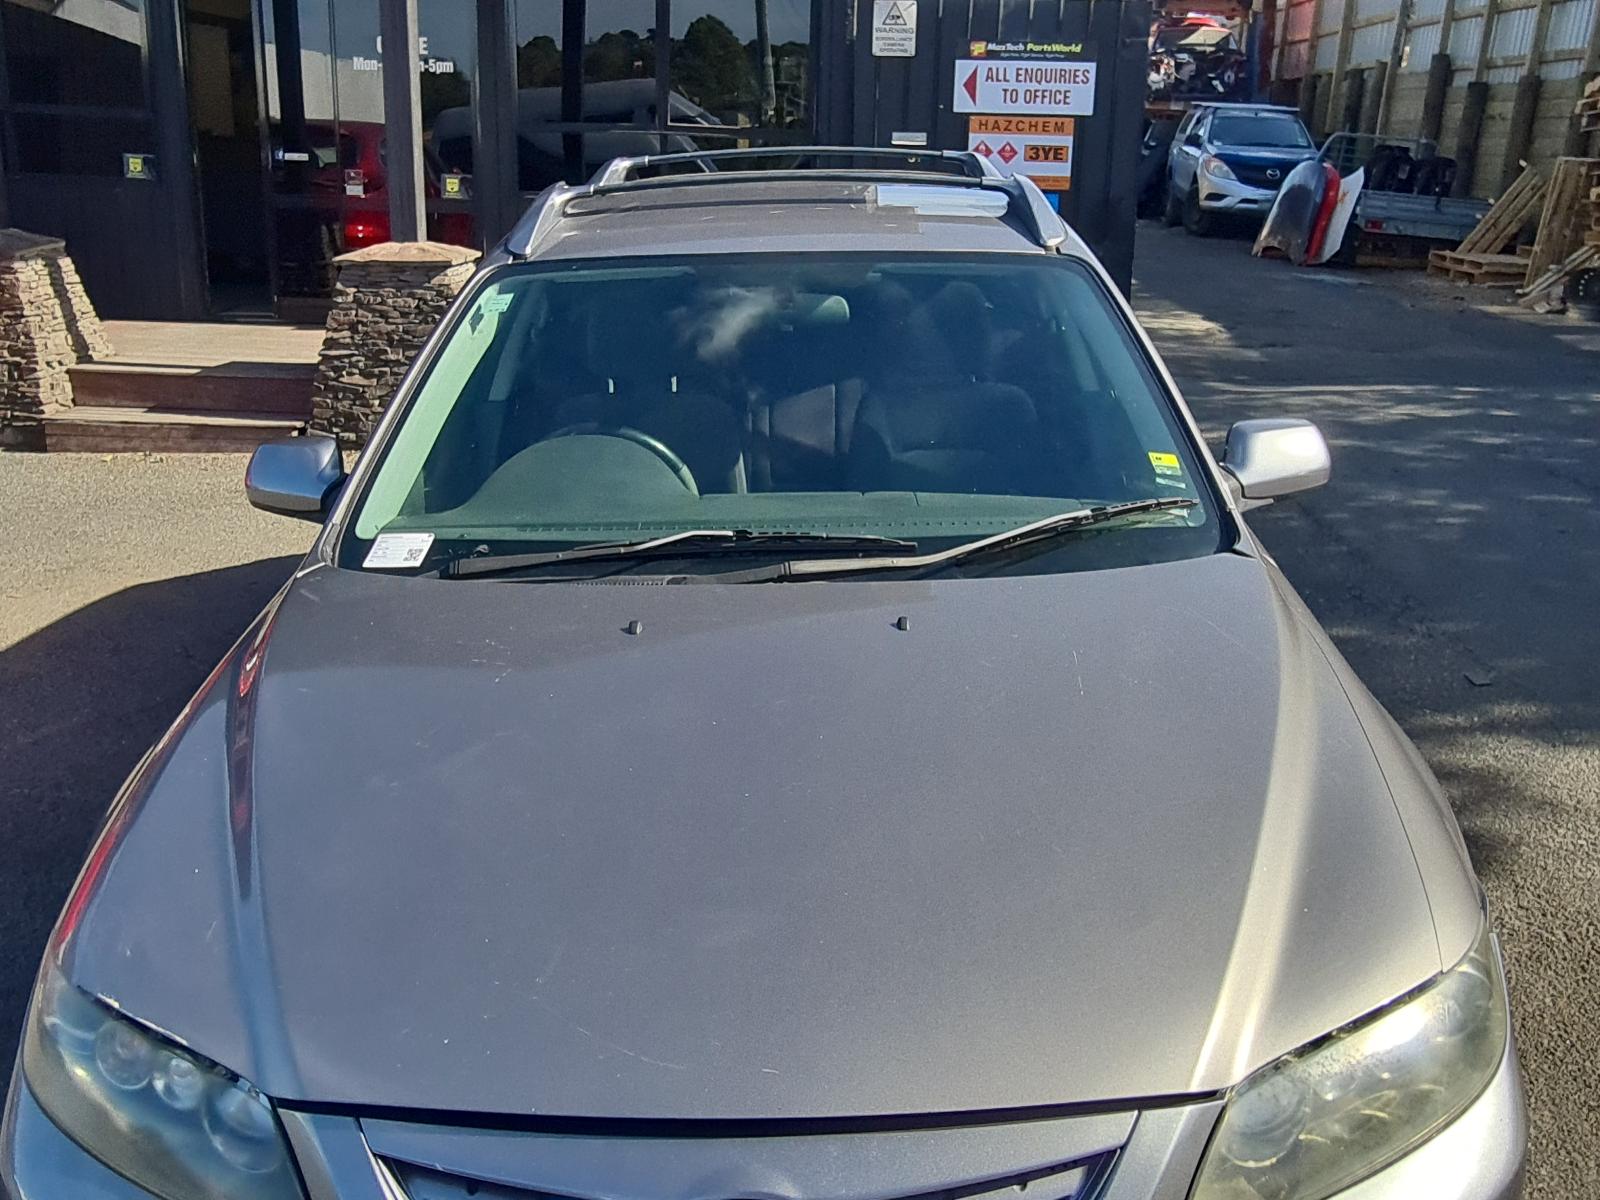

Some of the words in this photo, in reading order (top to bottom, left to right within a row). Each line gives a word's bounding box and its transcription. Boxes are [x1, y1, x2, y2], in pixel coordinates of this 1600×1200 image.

[352, 56, 383, 71] Mon-
[984, 67, 1010, 83] ALL
[1015, 67, 1090, 86] ENQUIRIES
[1002, 88, 1019, 104] TO
[1023, 89, 1071, 105] OFFICE
[978, 119, 1064, 133] HAZCHEM
[1028, 147, 1064, 161] 3YE
